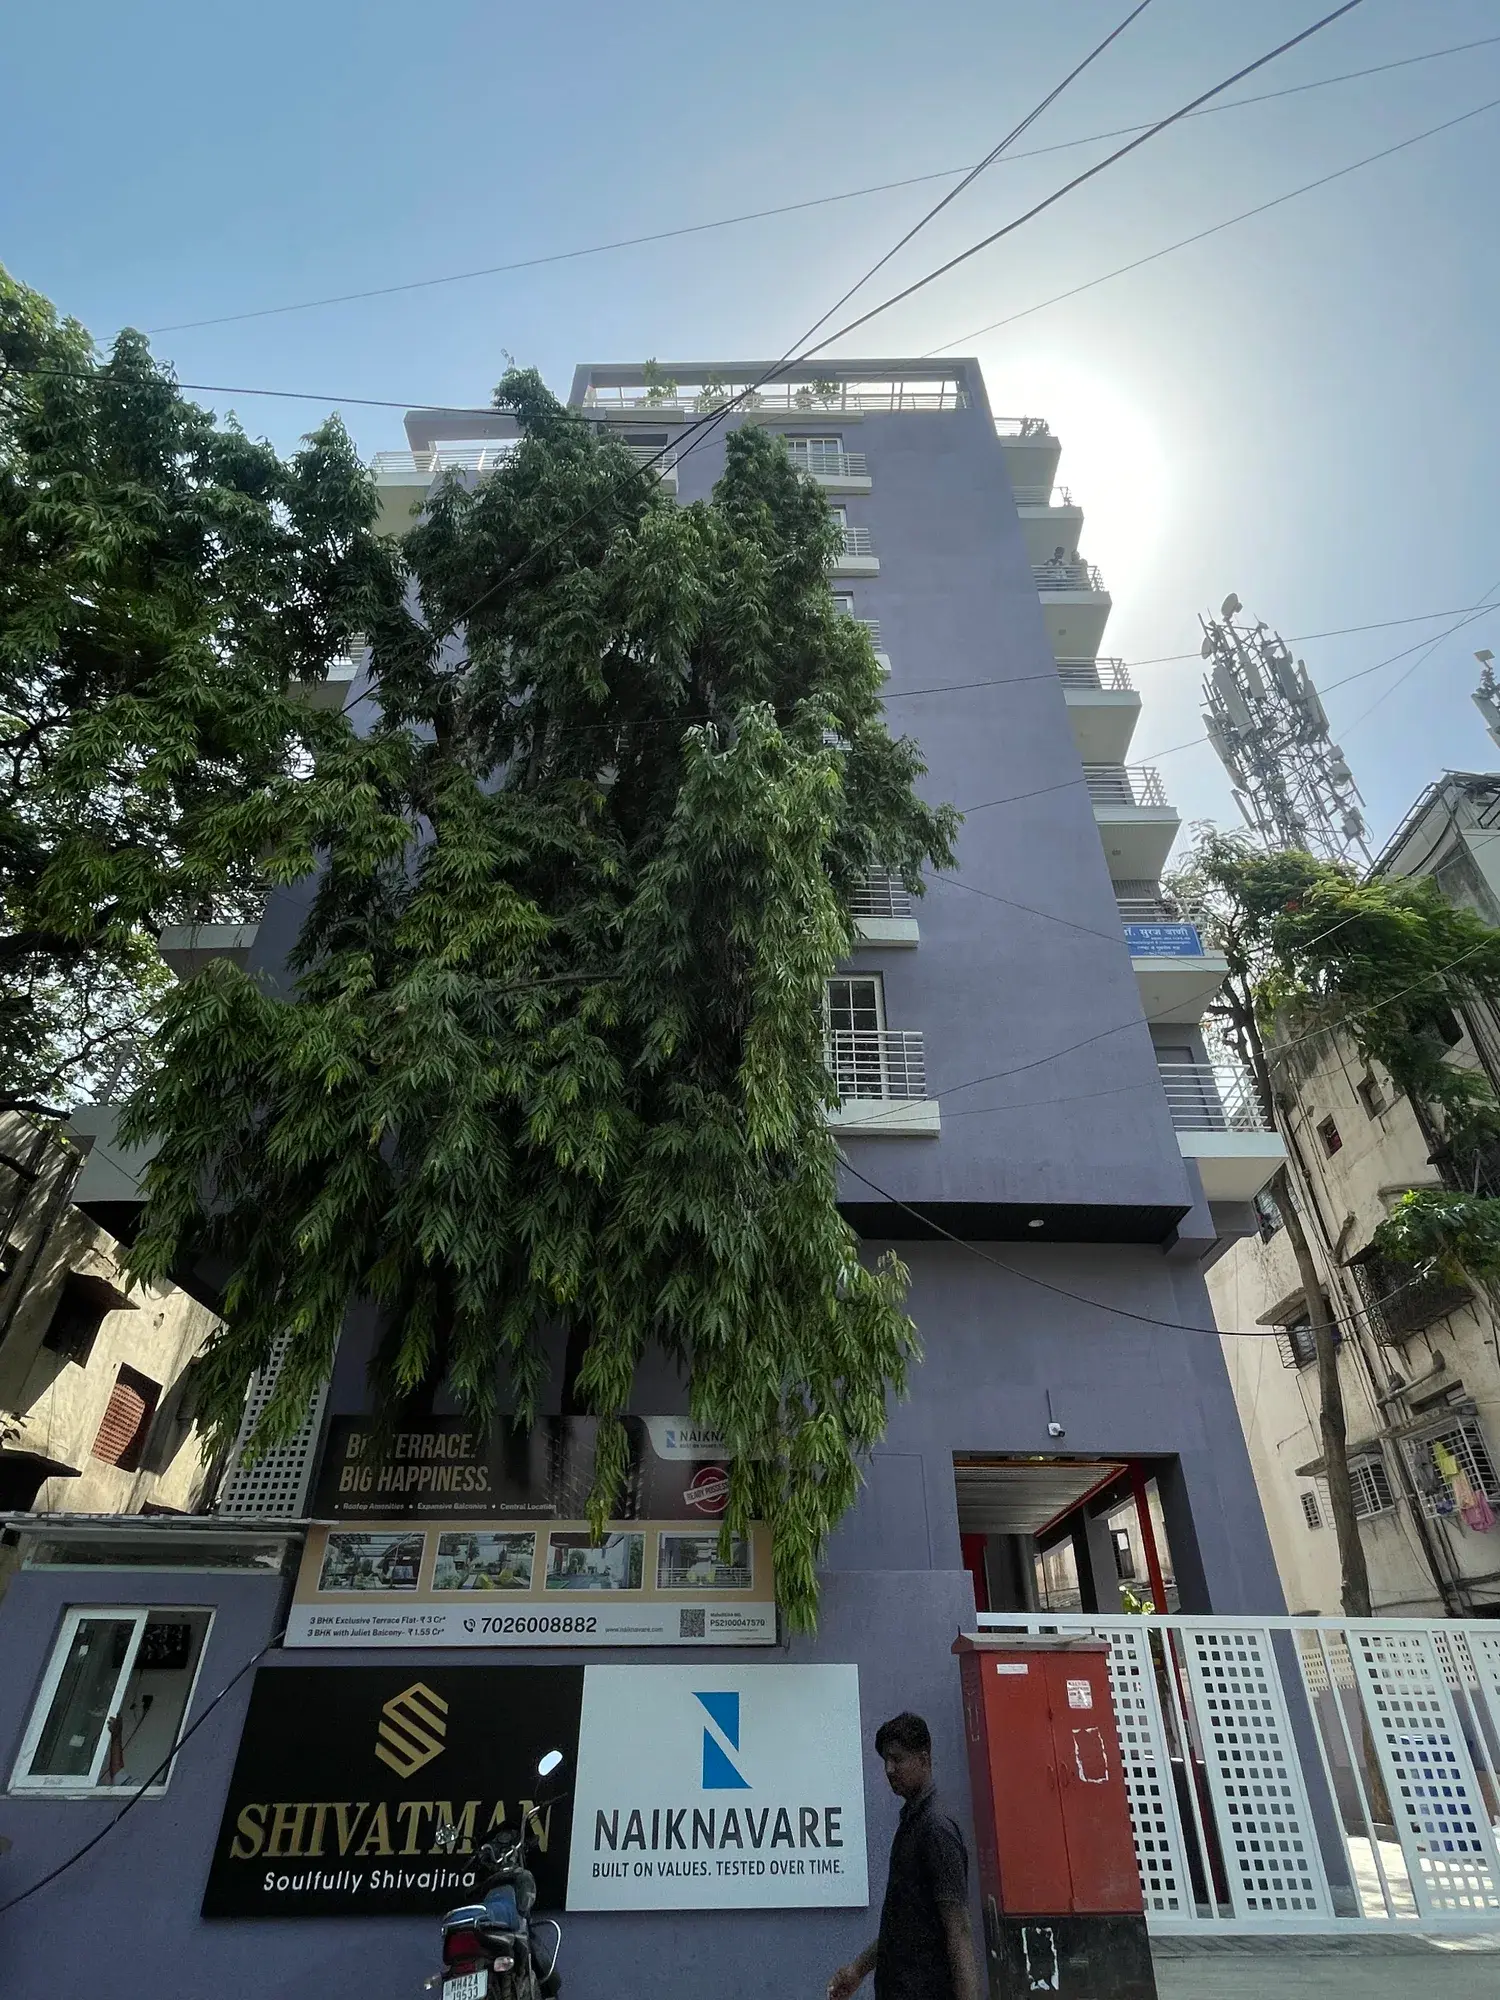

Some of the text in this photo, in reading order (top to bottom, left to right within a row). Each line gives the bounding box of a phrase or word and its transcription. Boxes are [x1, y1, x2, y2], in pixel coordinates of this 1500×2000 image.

[345, 1433, 476, 1459] BI ERRACE.
[338, 1466, 492, 1492] BIG HAPPINESS.
[368, 1502, 405, 1510] Amenities
[417, 1502, 452, 1511] Expansive
[453, 1502, 487, 1510] Balconies
[500, 1502, 526, 1510] Central
[310, 1616, 316, 1625] 3
[316, 1616, 334, 1625] BHK
[335, 1616, 371, 1625] Exclusive
[372, 1616, 400, 1625] Terrace
[427, 1615, 433, 1624] 3
[481, 1617, 597, 1634] 7026008882
[307, 1629, 313, 1637] 3
[314, 1629, 332, 1637] BHK
[333, 1629, 349, 1637] with
[350, 1628, 371, 1637] Juliet
[594, 1806, 844, 1851] NAIKNAVARE
[592, 1859, 845, 1878] BUILT ON VALUES. TESTED OVER TIME.
[263, 1870, 363, 1893] Soulfully
[451, 1973, 479, 1992] MH42A
